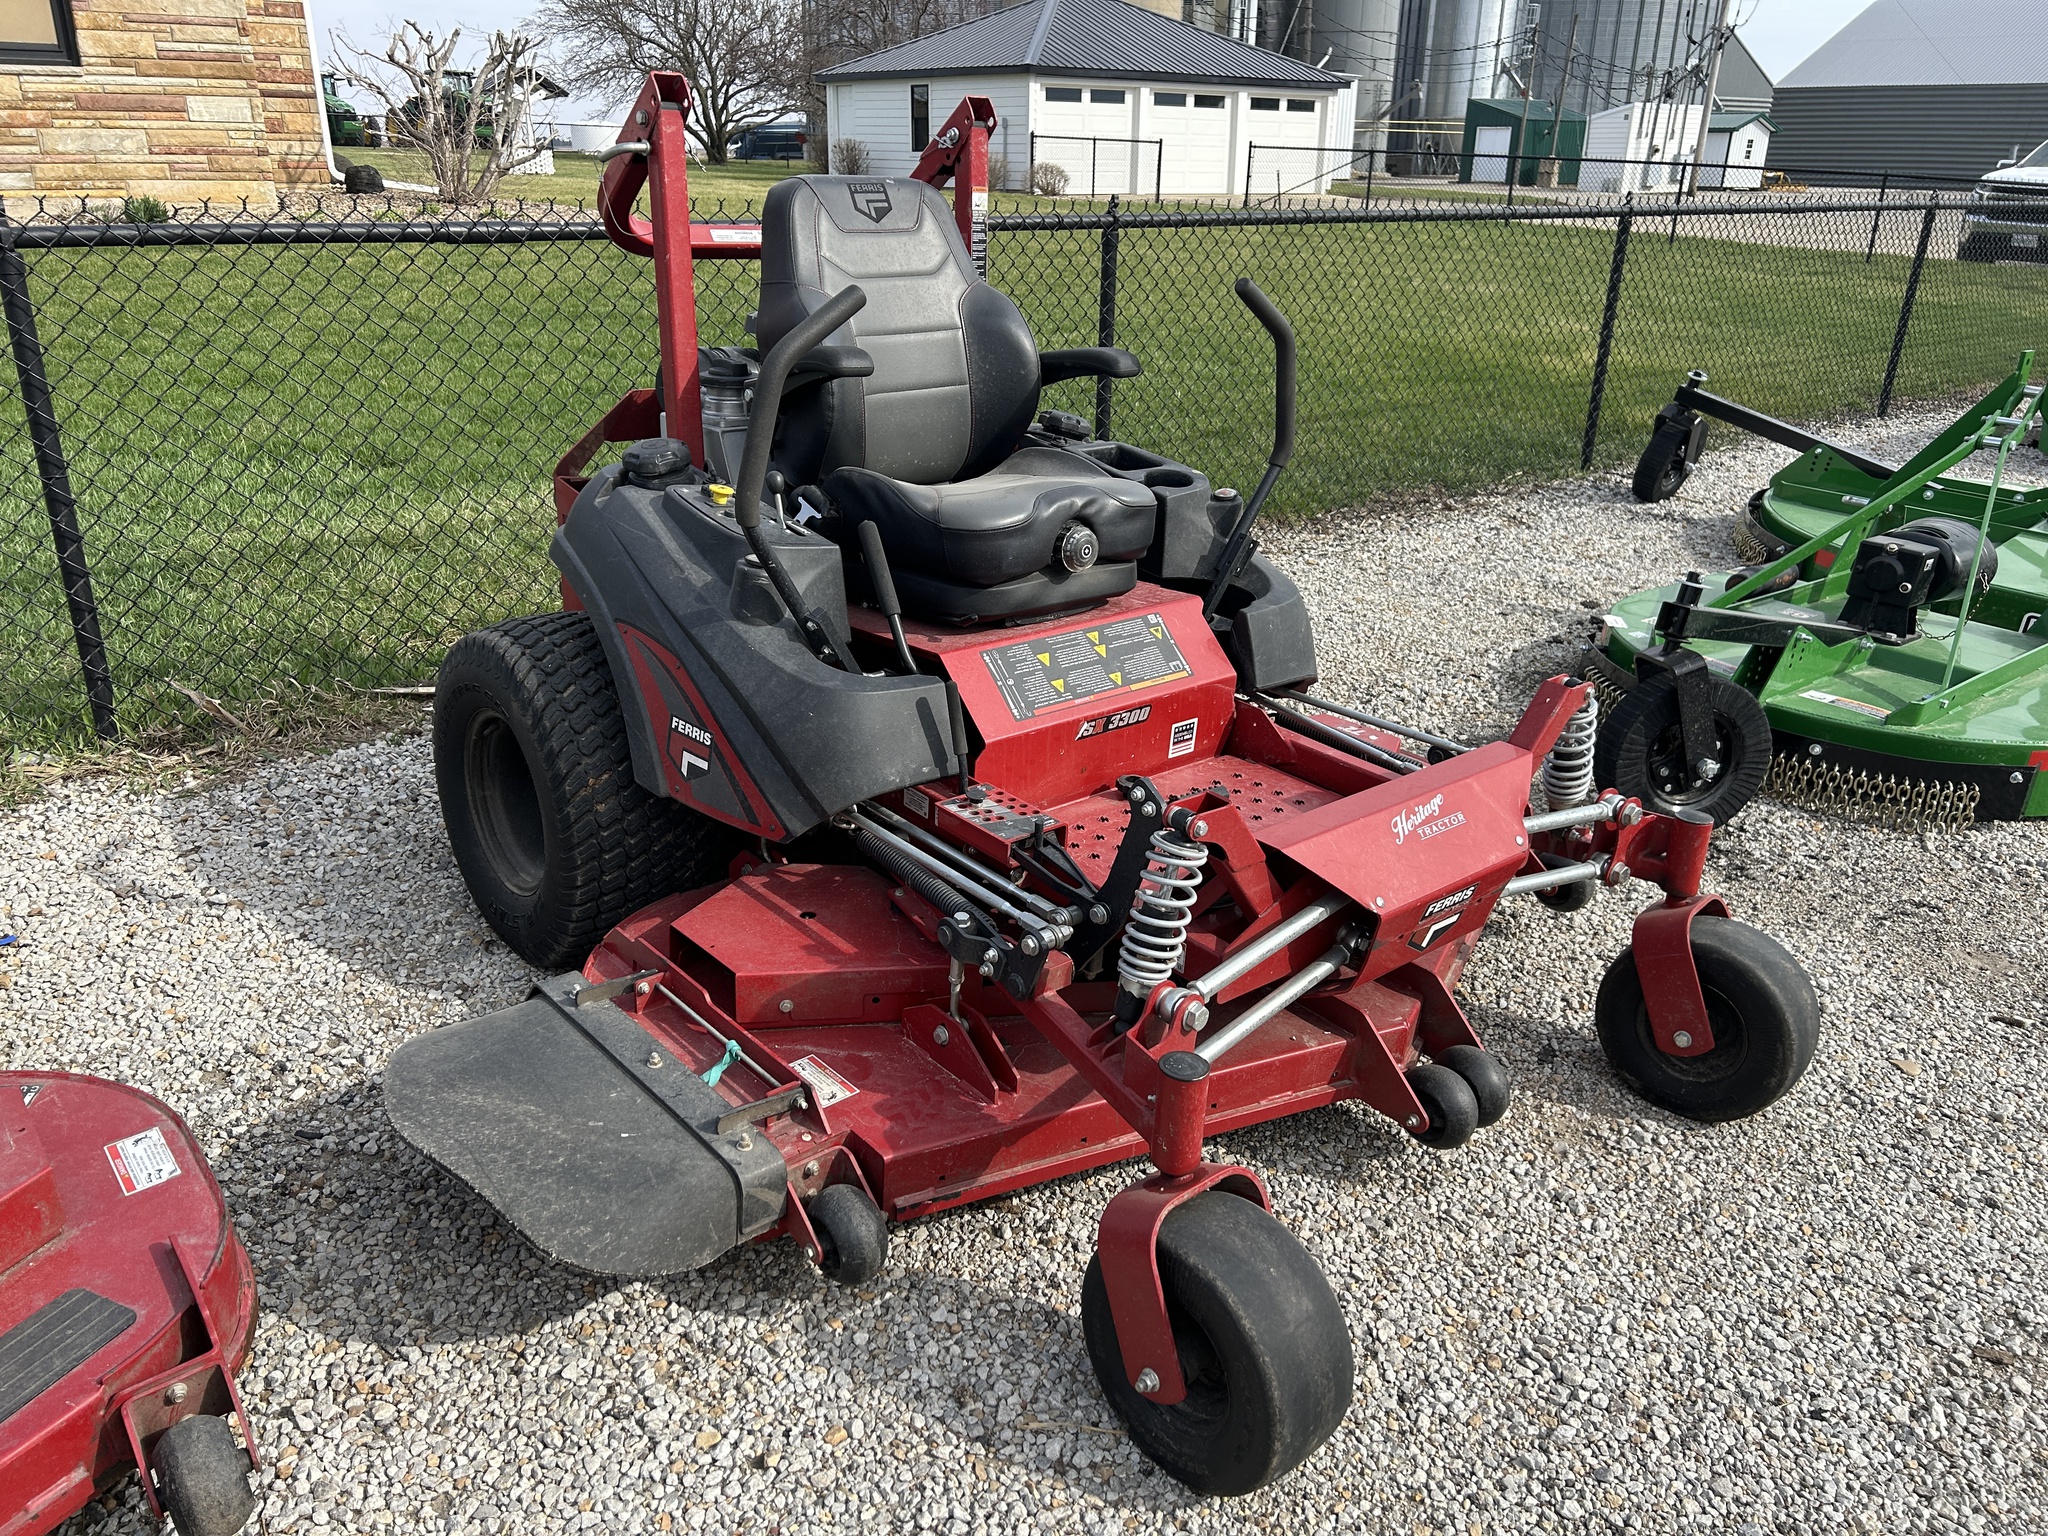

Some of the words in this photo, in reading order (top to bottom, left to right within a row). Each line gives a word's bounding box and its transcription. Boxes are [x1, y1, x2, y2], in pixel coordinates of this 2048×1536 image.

[850, 183, 884, 192] FERRIS
[671, 716, 712, 746] FERRIS
[1108, 706, 1151, 729] 3300
[1391, 793, 1444, 845] Heritage
[1417, 812, 1466, 838] TRACTOR
[1424, 886, 1475, 917] FERRIS
